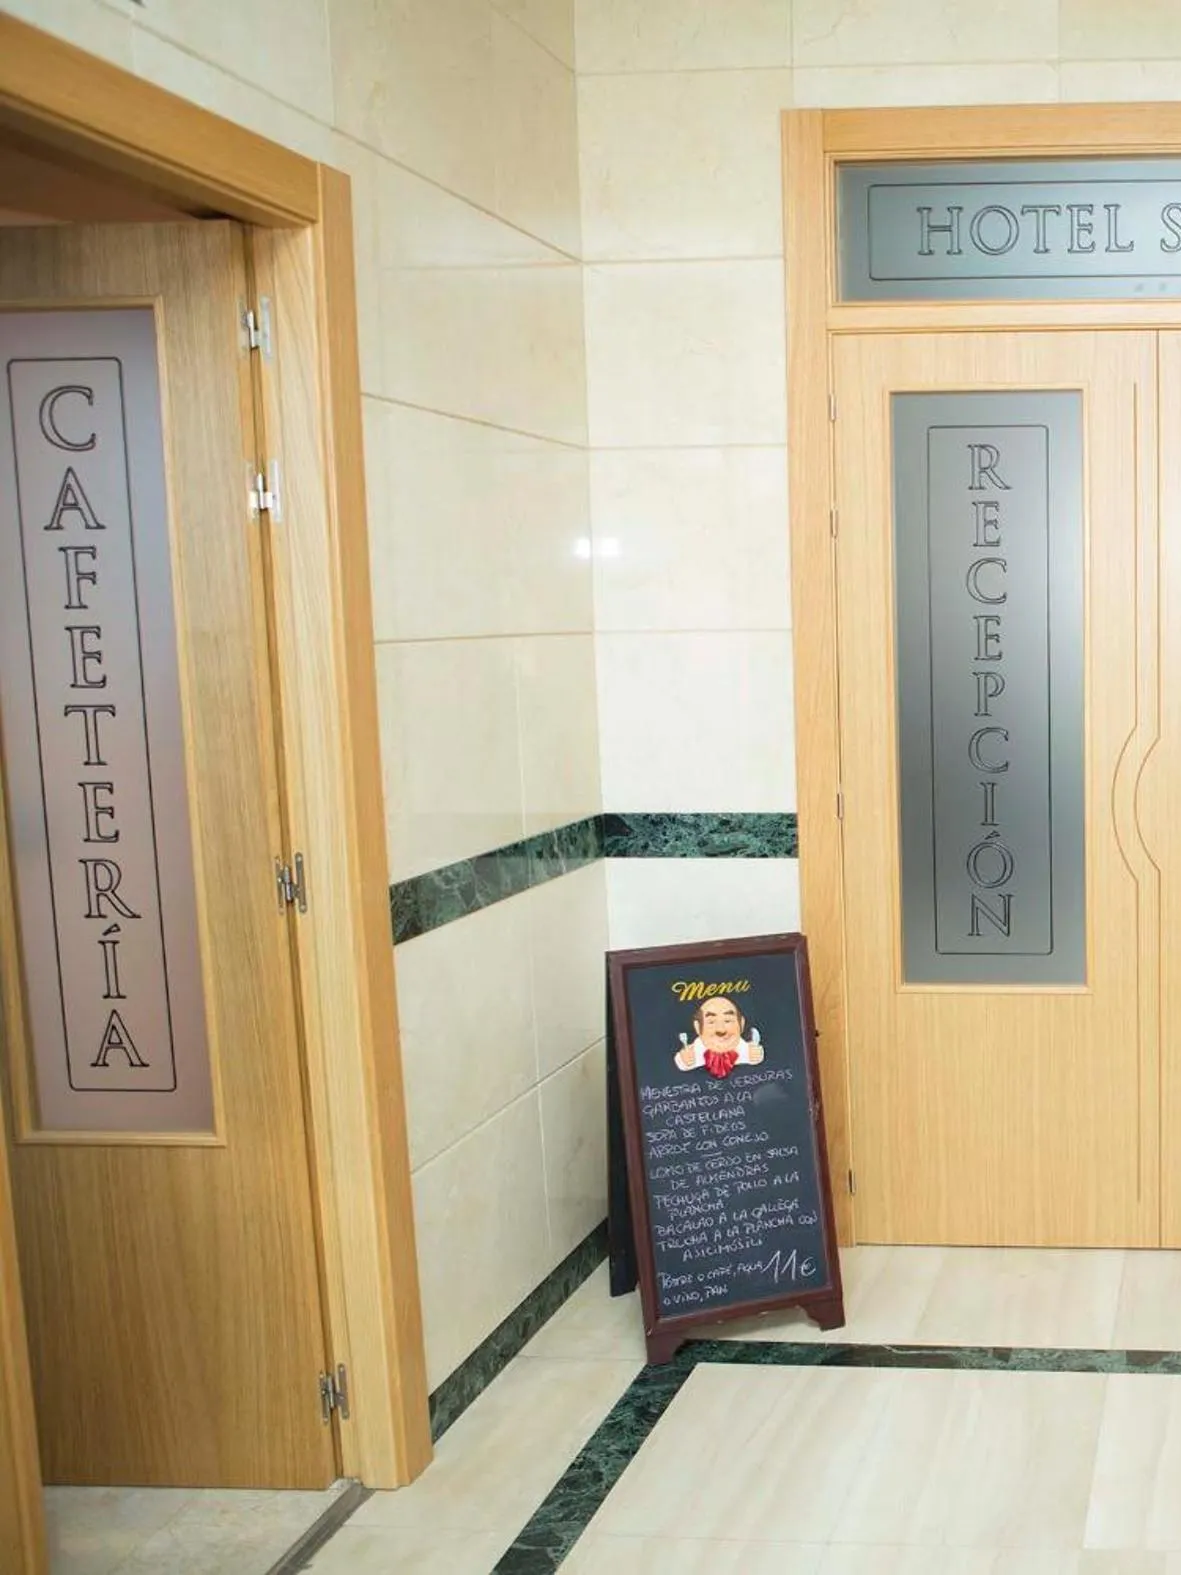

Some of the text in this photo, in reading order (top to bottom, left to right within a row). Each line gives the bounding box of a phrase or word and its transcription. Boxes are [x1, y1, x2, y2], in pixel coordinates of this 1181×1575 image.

[917, 203, 1134, 257] HOTEL
[966, 443, 1014, 937] RECEPCIÓN
[38, 384, 149, 1069] CAFETERÍA
[640, 1069, 793, 1101] MENESTRA DE VERDURAS
[643, 1096, 719, 1119] GARBANZOS
[665, 1105, 745, 1128] CASTELLANA
[646, 1121, 747, 1143] SOPA DE FIDEOS
[695, 1139, 718, 1151] CON
[722, 1131, 769, 1147] CONEJO
[651, 1146, 799, 1180] LOMO DE CERDO EN SALSA
[671, 1163, 769, 1191] DE ALMENDRAS
[715, 1185, 731, 1198] DE
[734, 1179, 768, 1194] POLLO
[773, 1174, 783, 1185] A
[784, 1171, 799, 1183] LA
[656, 1198, 801, 1237] BACALAO A LA GALLEGA
[668, 1200, 725, 1221] PLANCHA
[714, 1229, 722, 1243] A
[727, 1225, 740, 1238] LA
[744, 1214, 794, 1234] PLANCHA
[798, 1210, 818, 1226] CON
[762, 1249, 817, 1284] 11€
